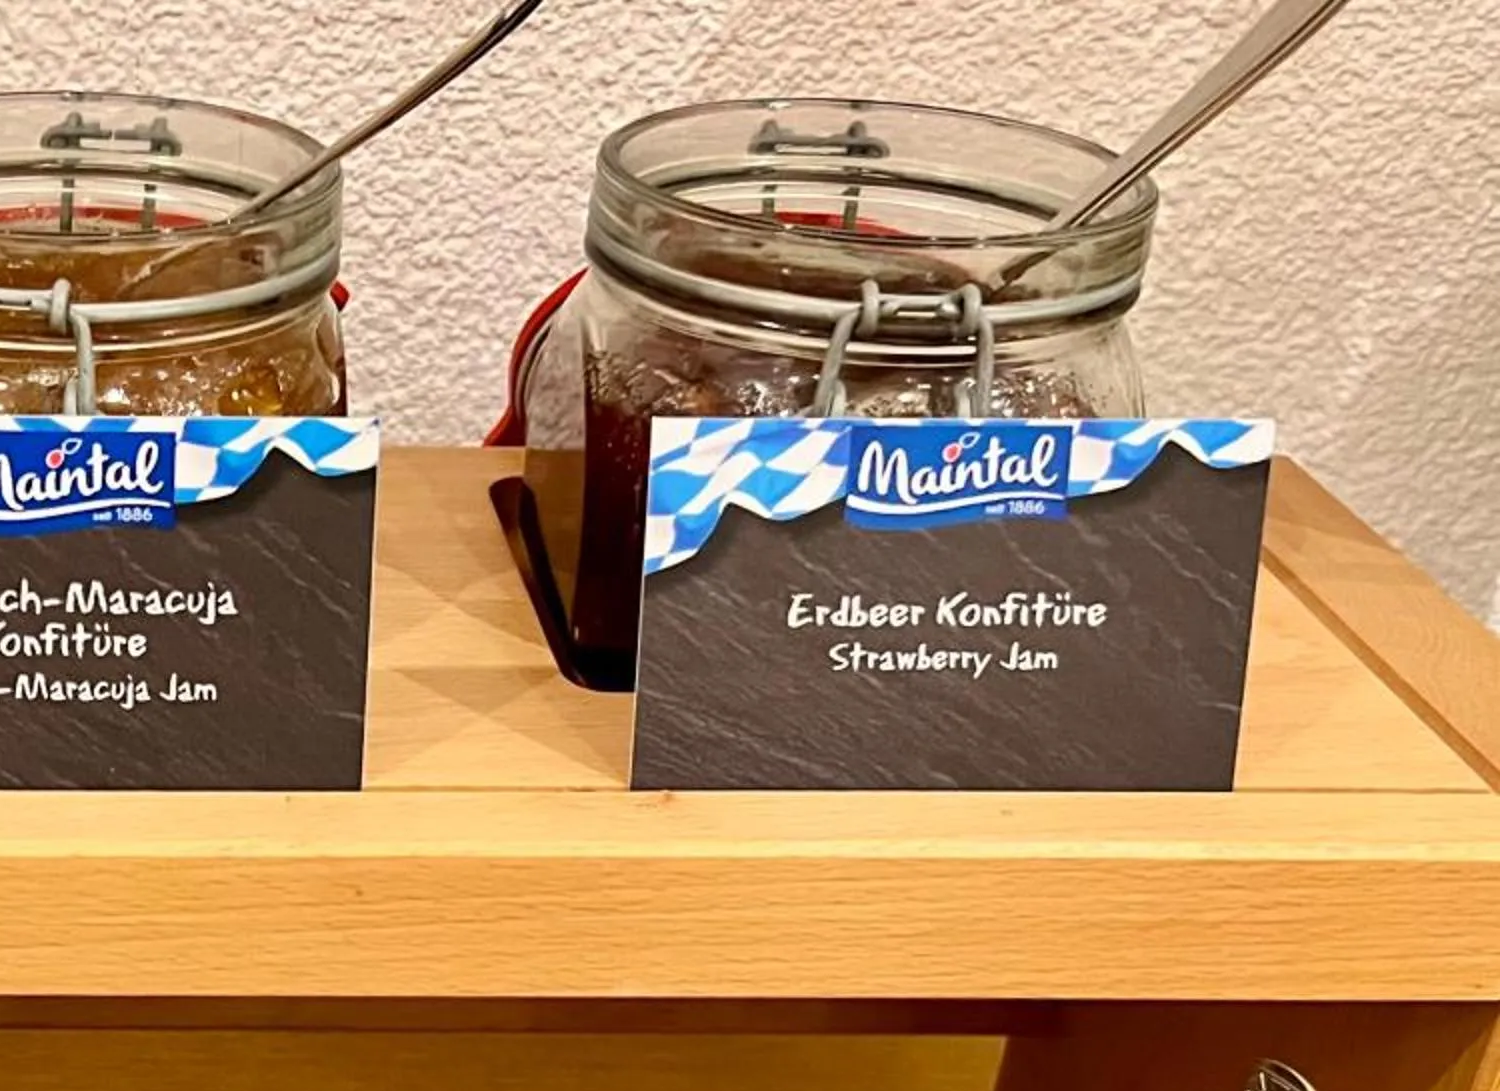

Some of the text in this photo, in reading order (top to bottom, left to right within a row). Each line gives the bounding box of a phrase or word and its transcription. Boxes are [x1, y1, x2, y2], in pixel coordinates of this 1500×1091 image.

[859, 433, 1059, 503] Maintal
[116, 507, 153, 522] 1886
[1007, 499, 1046, 515] 1886
[787, 591, 1108, 629] Erdbeer Konfitüre
[828, 641, 1059, 680] Strawberry Jam
[159, 672, 217, 703] Jam
